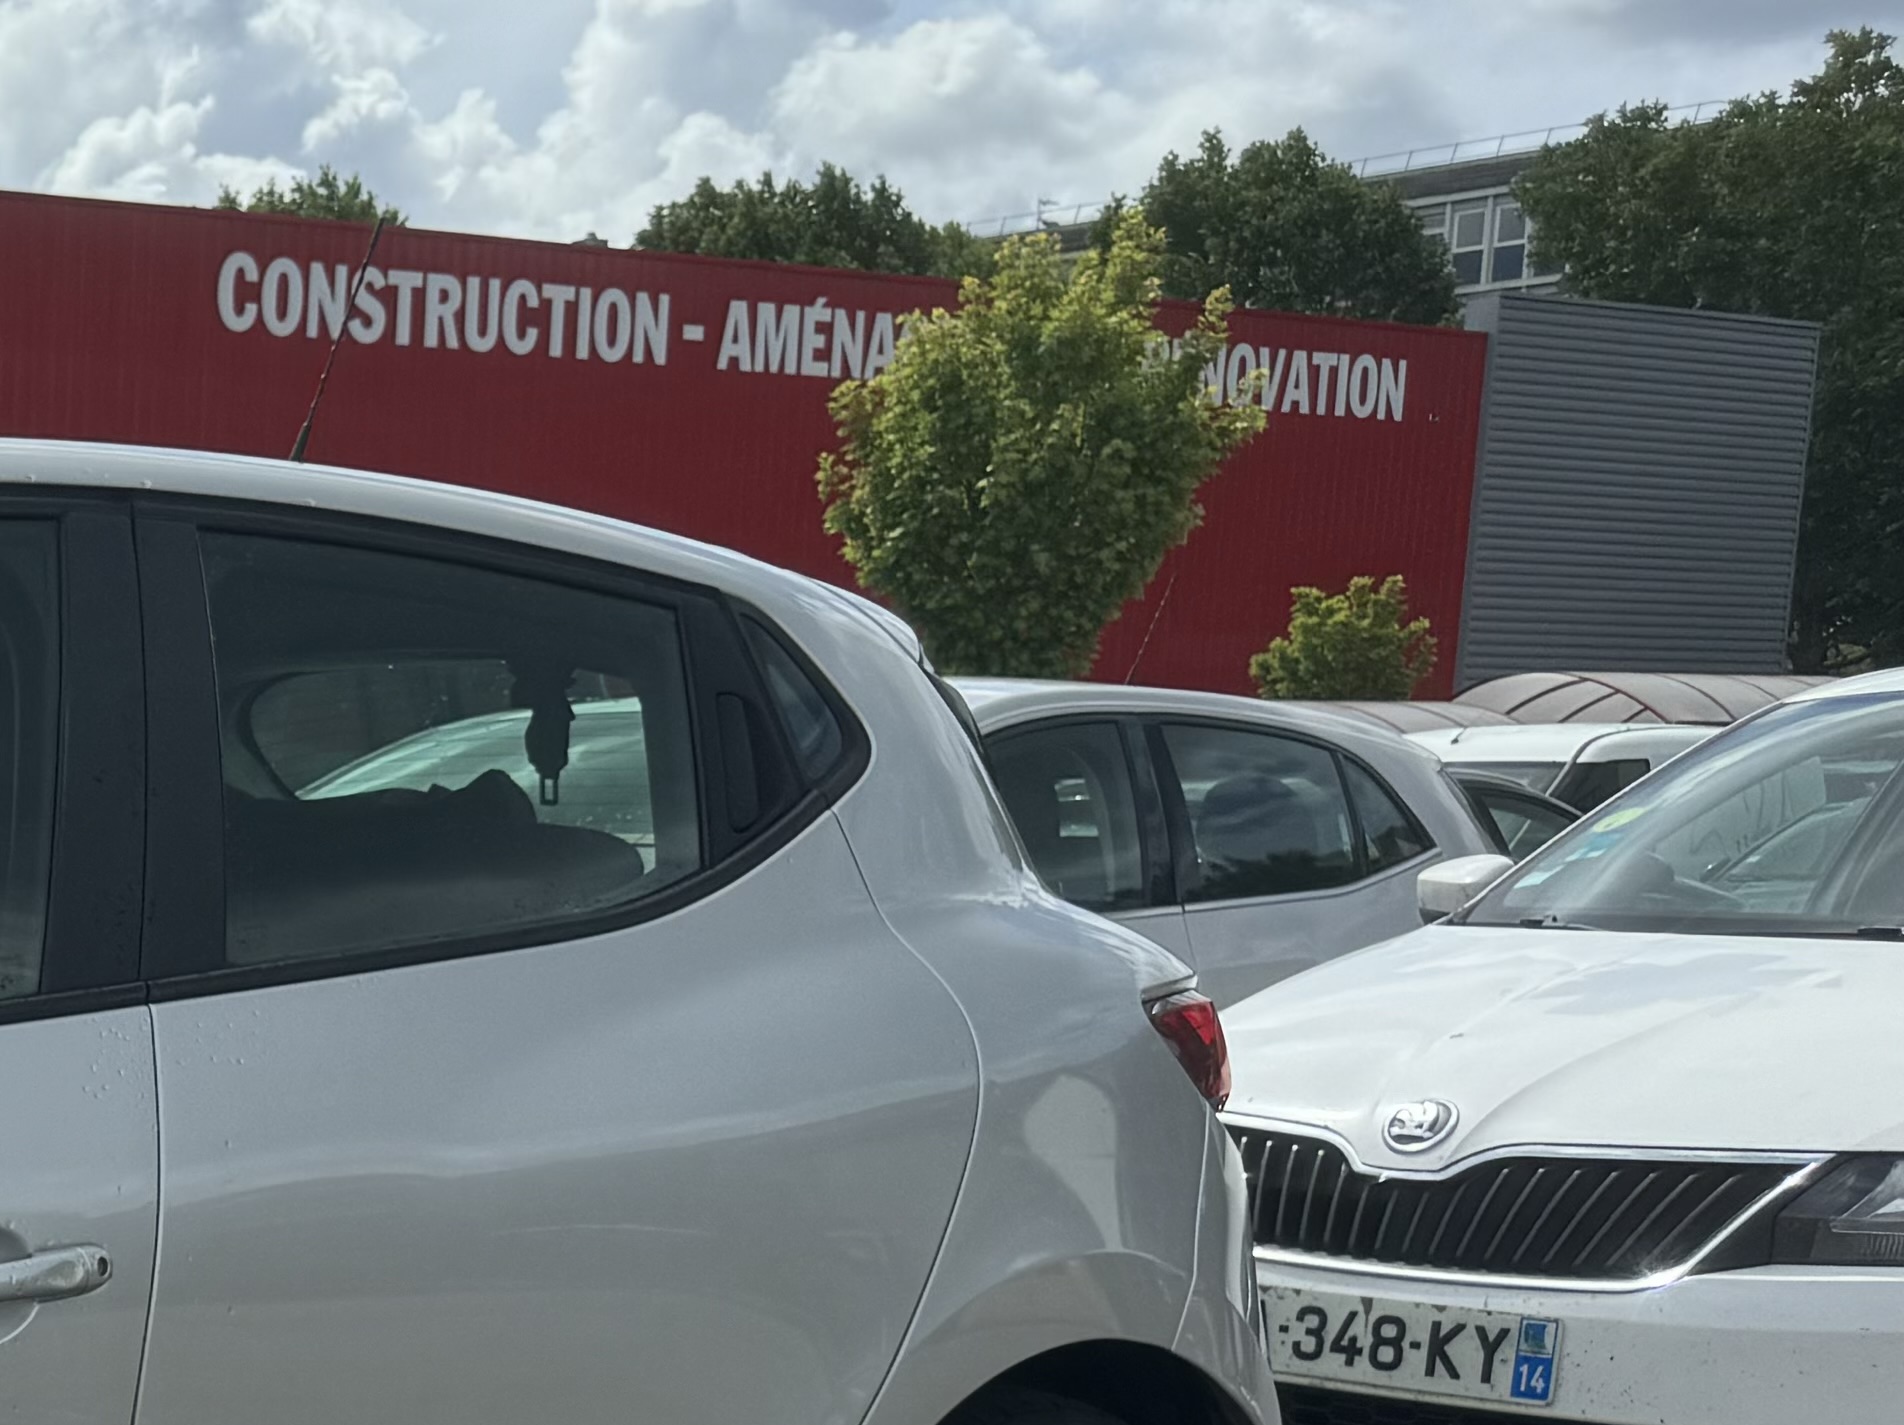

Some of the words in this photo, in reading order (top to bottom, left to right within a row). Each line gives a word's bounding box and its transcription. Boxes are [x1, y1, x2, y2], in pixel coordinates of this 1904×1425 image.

[217, 251, 670, 366] CONSTRUCTION
[716, 297, 912, 380] AMÉNA
[1143, 334, 1407, 422] NOVATION
[1518, 1362, 1546, 1394] 14
